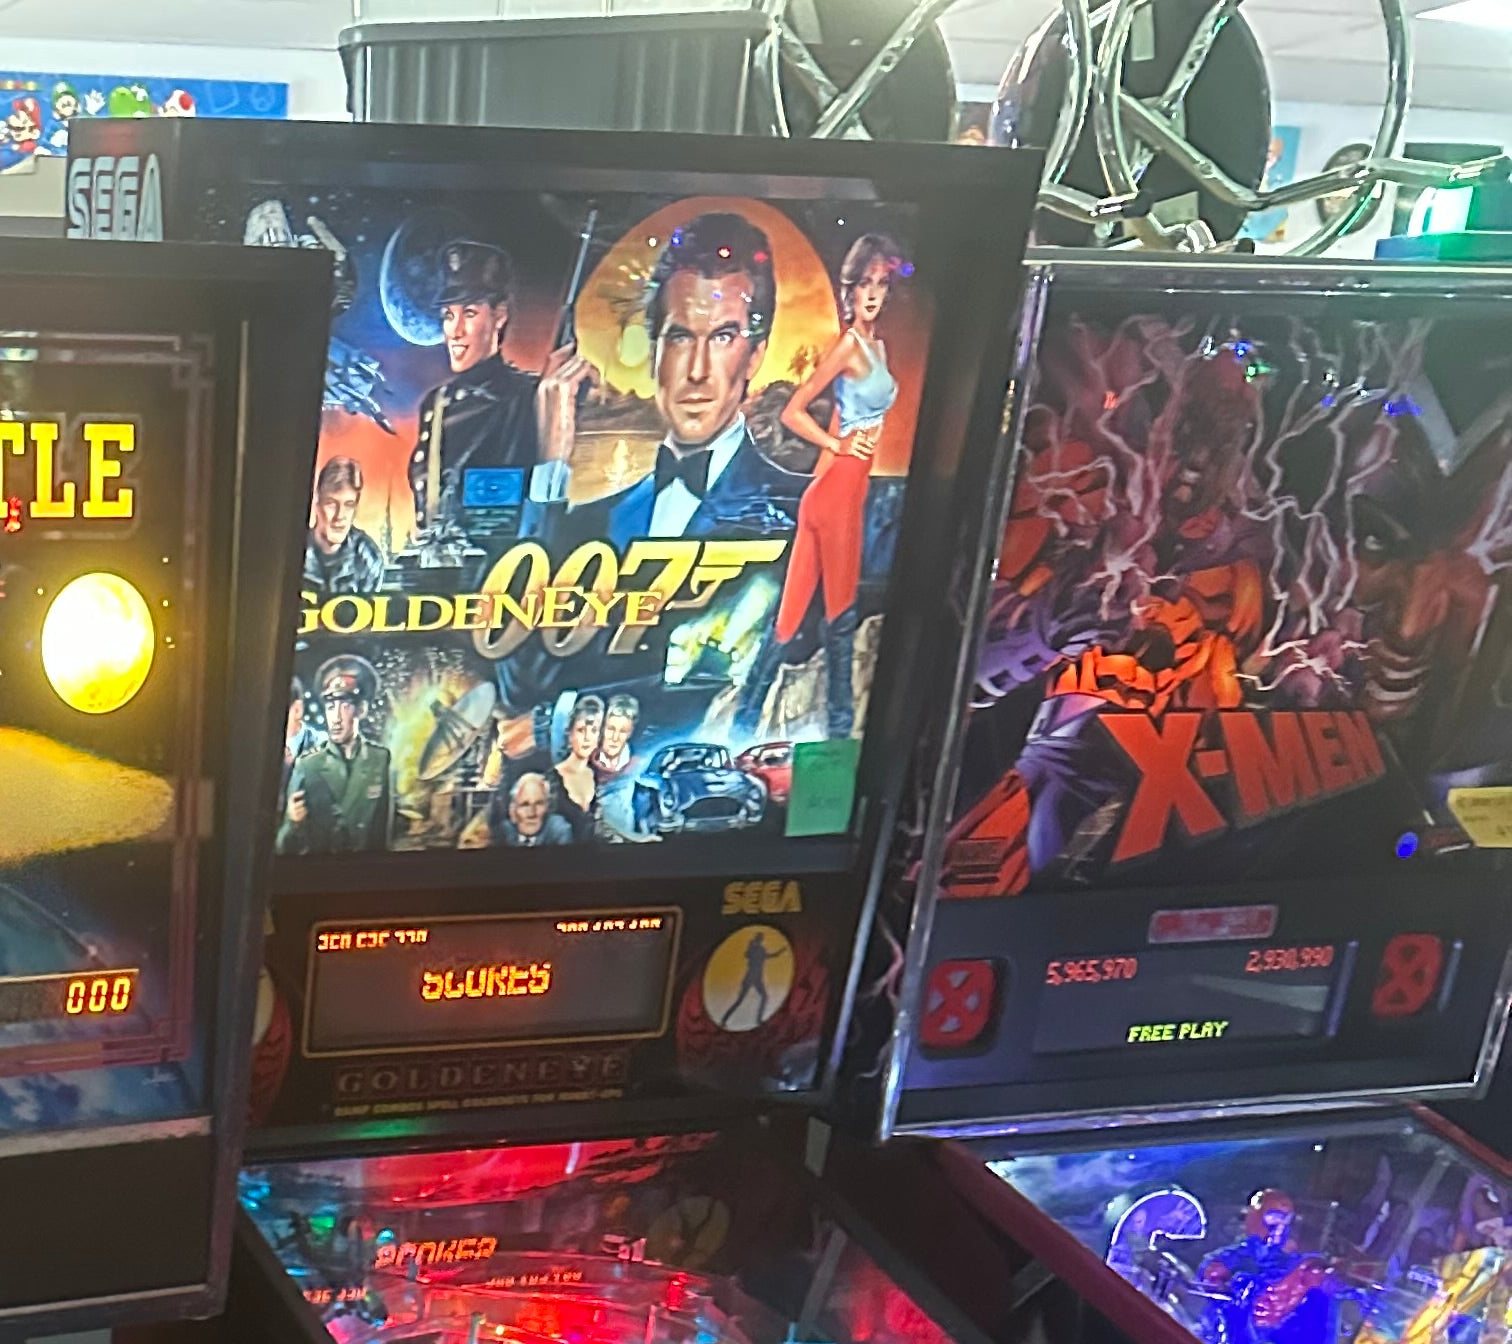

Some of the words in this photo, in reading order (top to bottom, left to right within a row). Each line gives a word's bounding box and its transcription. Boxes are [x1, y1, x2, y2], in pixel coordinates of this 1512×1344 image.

[67, 153, 164, 242] SEGA
[471, 537, 787, 661] 007
[1098, 710, 1386, 862] X-MEN
[724, 880, 802, 915] SEGA
[65, 976, 131, 1015] 000
[1127, 1022, 1176, 1043] FREE
[1178, 1019, 1229, 1040] PLAY
